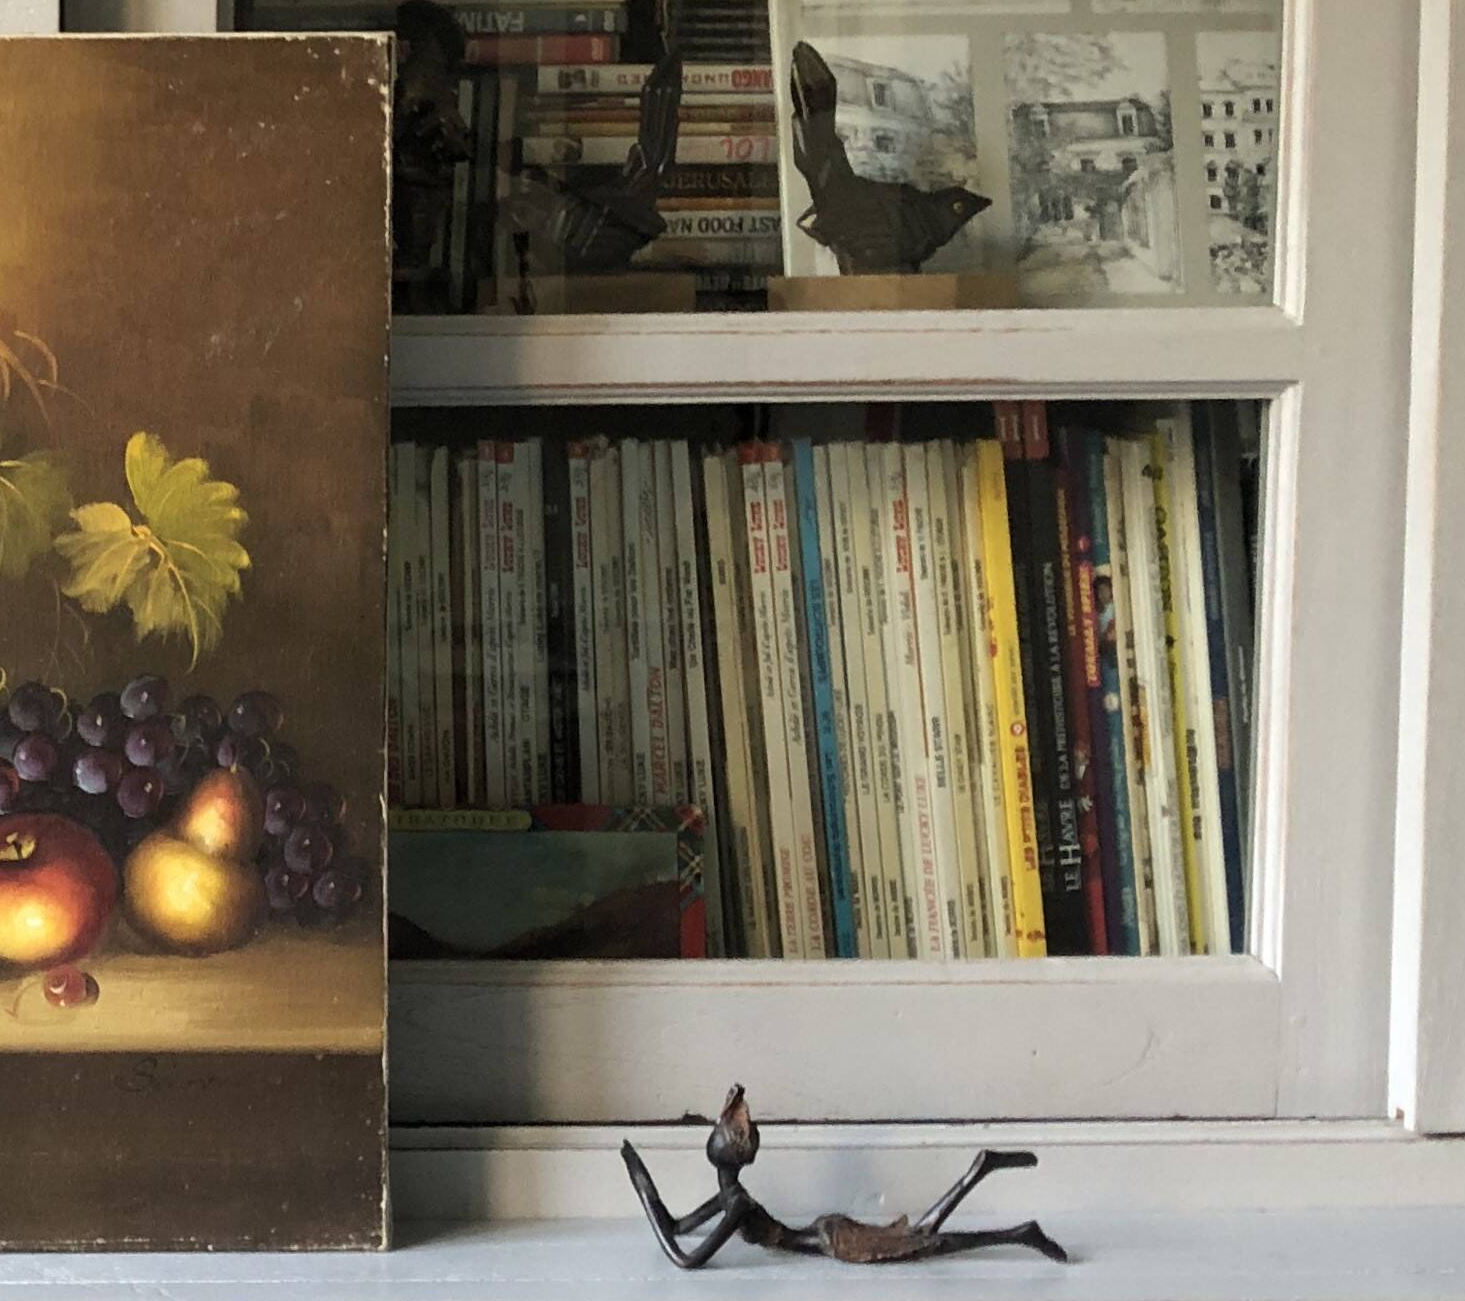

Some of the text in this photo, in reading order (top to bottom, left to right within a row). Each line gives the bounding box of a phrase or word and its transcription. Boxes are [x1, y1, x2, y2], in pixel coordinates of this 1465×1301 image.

[453, 10, 526, 33] FATIM
[696, 216, 745, 235] FOOD
[1084, 619, 1099, 684] TOTALLY
[647, 666, 668, 797] MARCEL DALTON
[932, 754, 947, 790] BELLE
[1057, 754, 1070, 772] LA
[1013, 745, 1036, 873] LES DIABLES
[917, 812, 934, 855] LUCKY
[1055, 798, 1083, 868] HAVRE
[921, 856, 935, 876] DE
[1065, 872, 1082, 894] LE
[778, 847, 799, 956] LA TERRE PROMISE
[804, 886, 821, 934] CORDE
[809, 936, 823, 954] LA
[928, 935, 942, 955] LA
